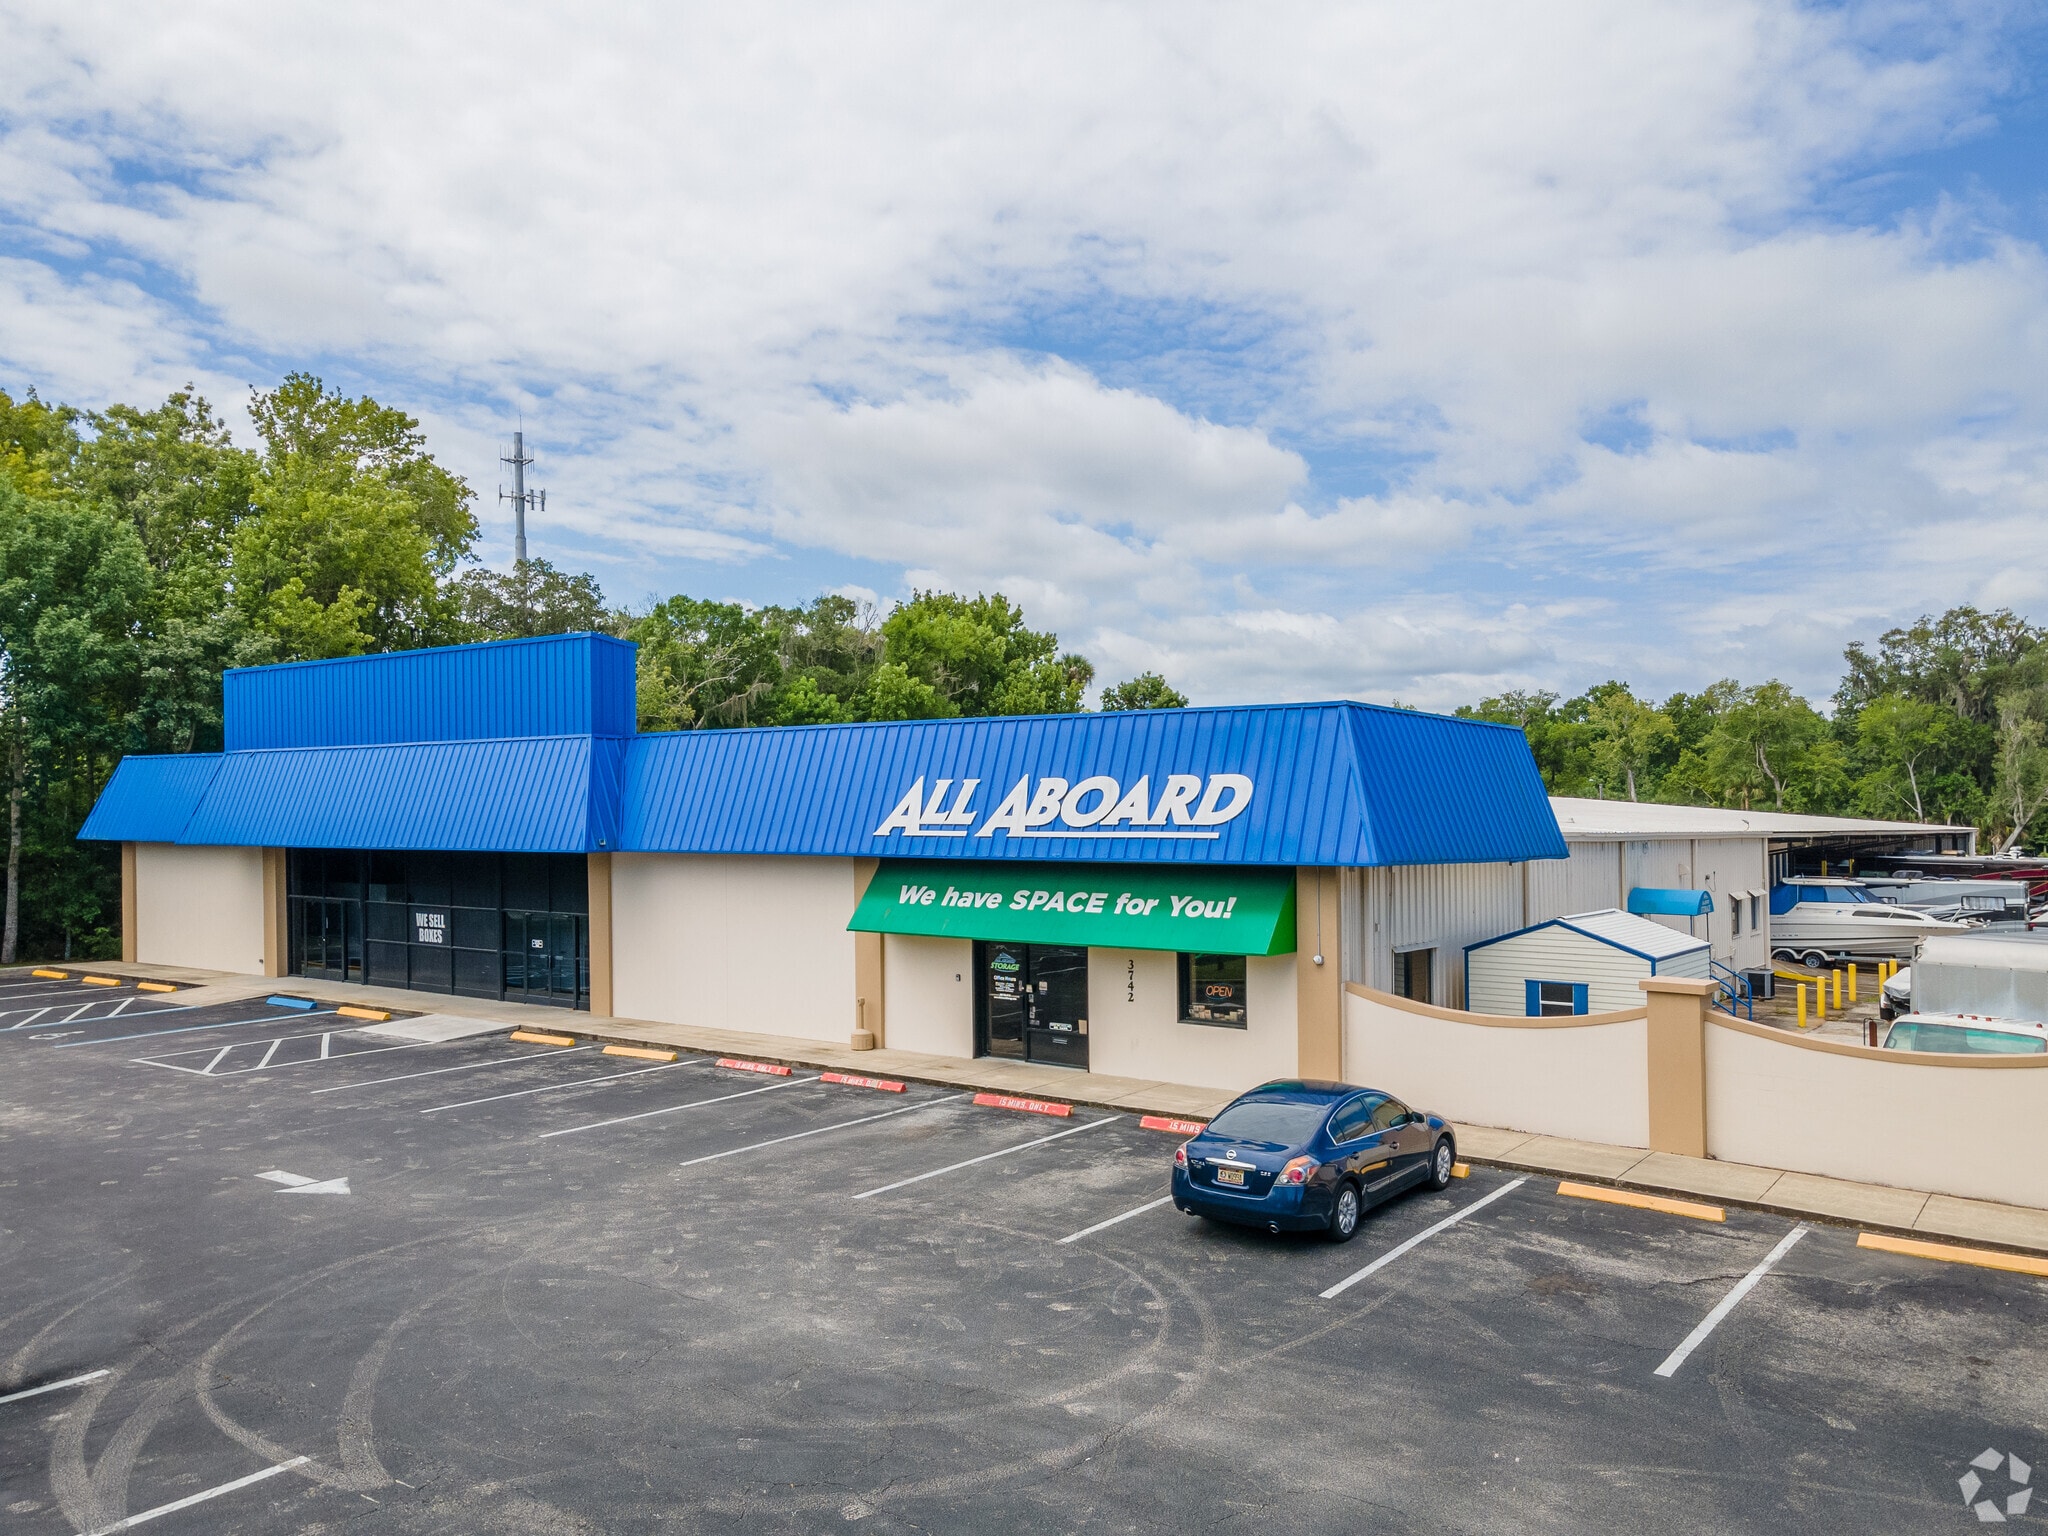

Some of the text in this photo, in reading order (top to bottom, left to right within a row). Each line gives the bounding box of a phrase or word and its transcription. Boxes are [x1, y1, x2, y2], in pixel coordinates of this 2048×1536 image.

[872, 773, 1254, 839] ALL ABOARD
[898, 885, 1238, 920] We have SPACE for You!
[416, 913, 445, 928] WE SELL
[419, 928, 443, 943] BOXES
[990, 961, 1020, 971] STORAGE
[1127, 959, 1135, 1002] 3742
[1205, 985, 1233, 997] OPEN
[999, 1097, 1007, 1106] 15
[1028, 1102, 1050, 1111] ONLY
[1168, 1121, 1179, 1130] 15
